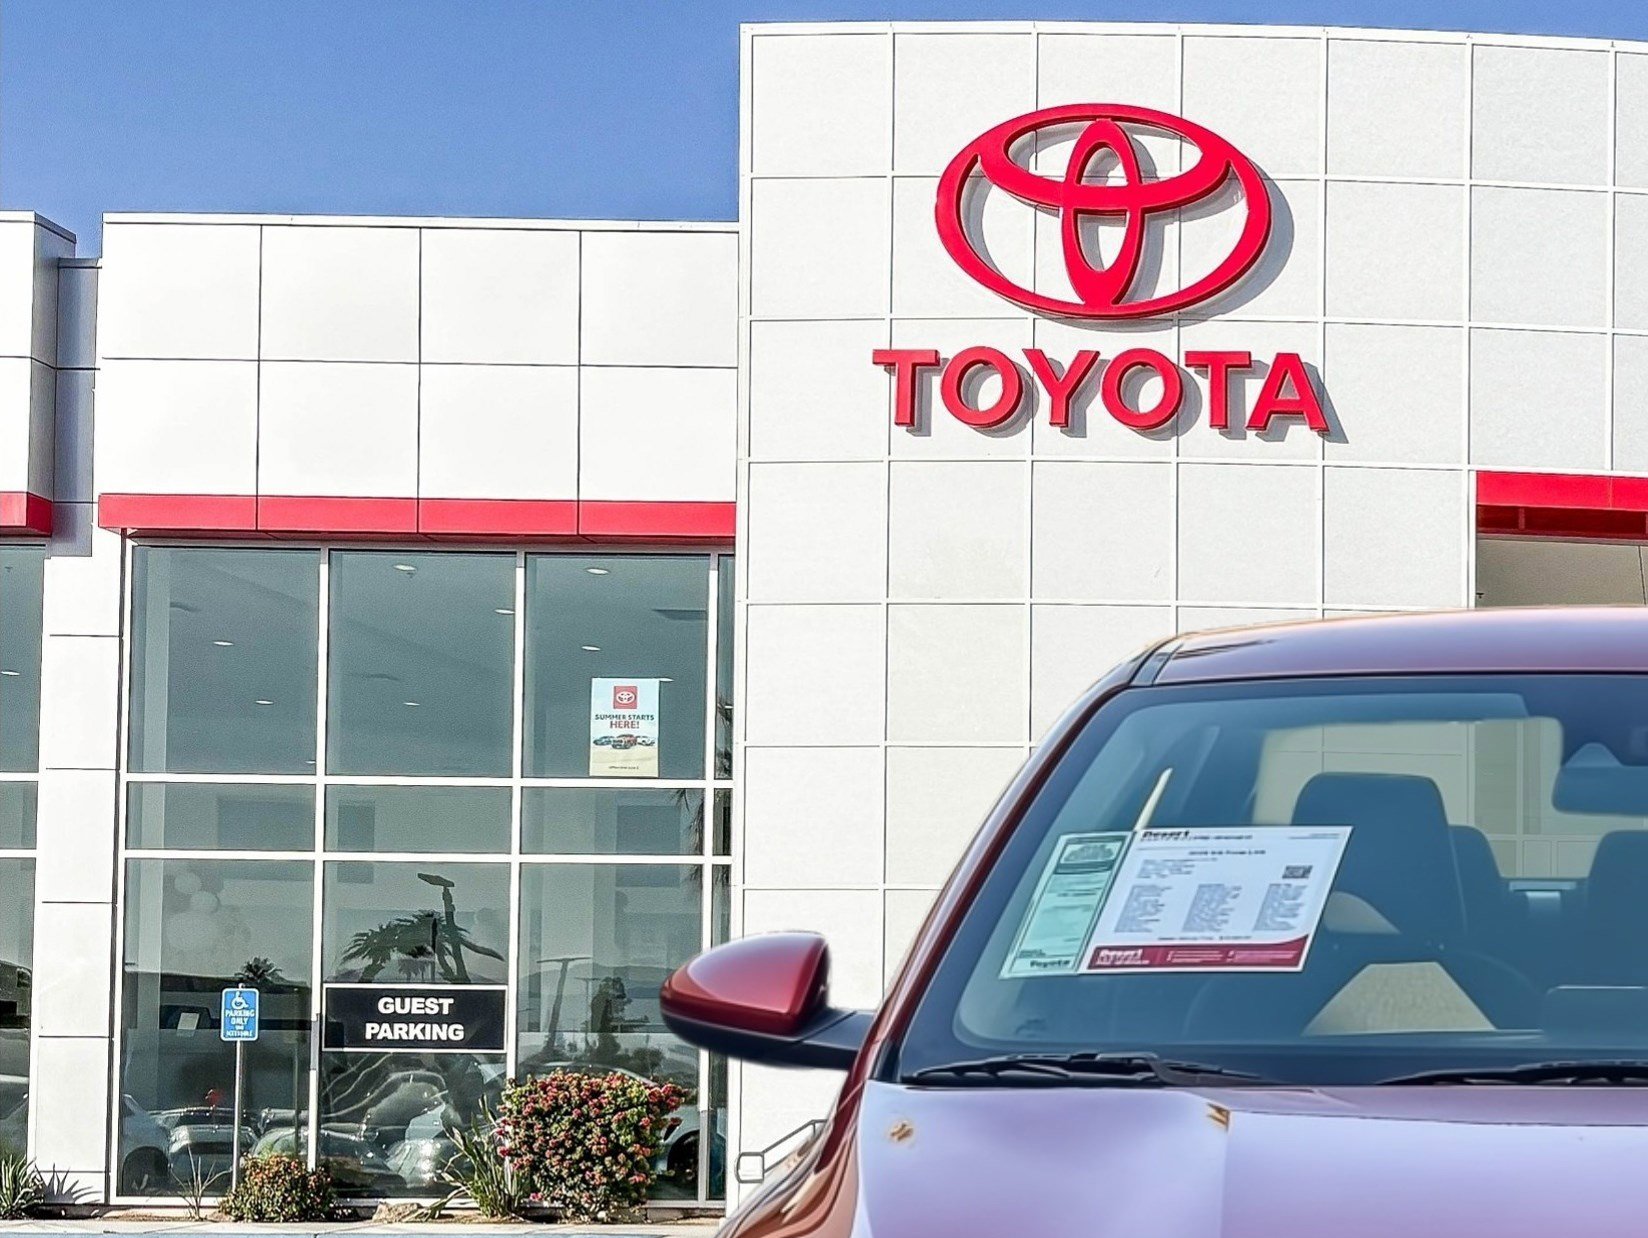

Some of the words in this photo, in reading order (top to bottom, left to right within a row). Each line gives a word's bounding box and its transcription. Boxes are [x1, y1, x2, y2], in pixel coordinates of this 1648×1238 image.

[873, 346, 1330, 433] TOYOTA
[609, 720, 640, 729] HERE!
[378, 997, 454, 1015] GUEST
[365, 1022, 465, 1041] PARKING
